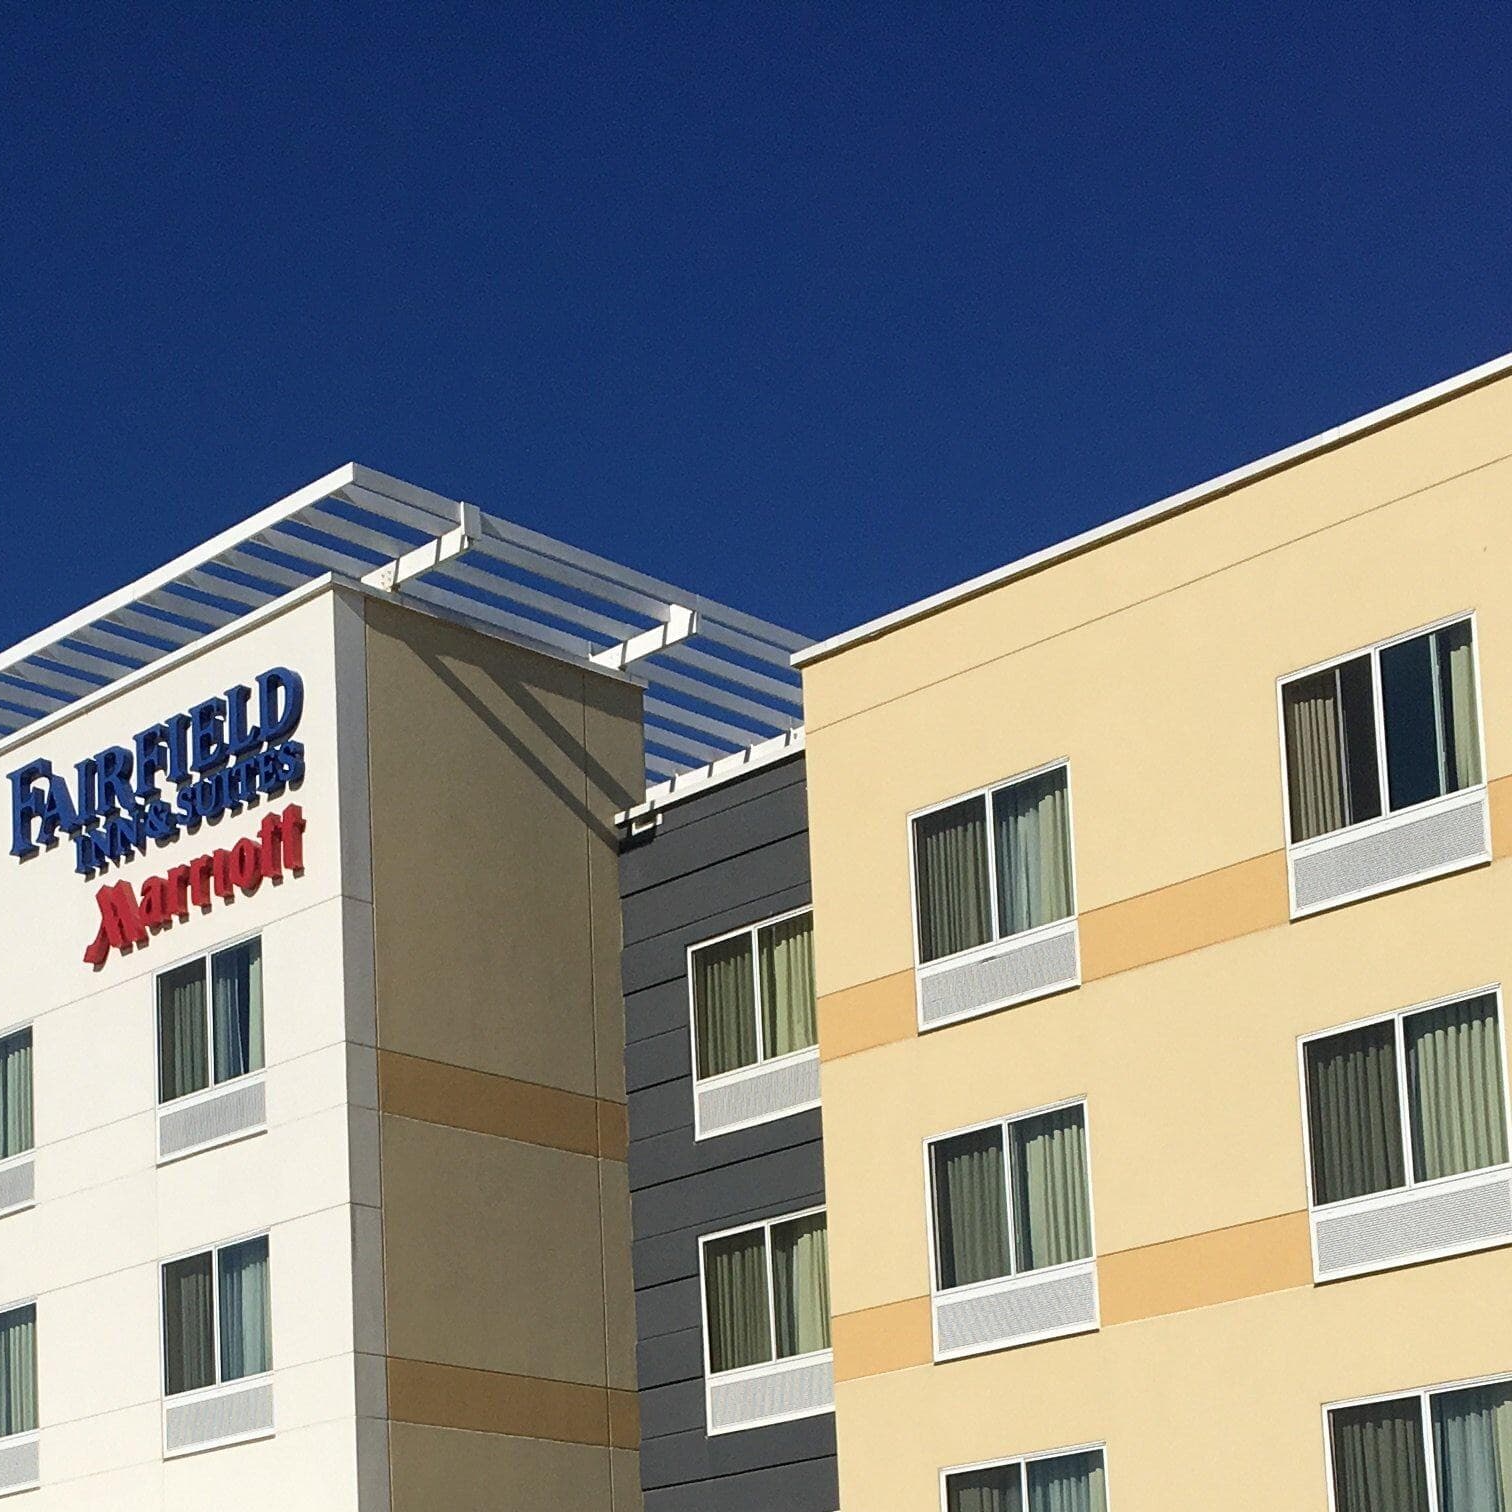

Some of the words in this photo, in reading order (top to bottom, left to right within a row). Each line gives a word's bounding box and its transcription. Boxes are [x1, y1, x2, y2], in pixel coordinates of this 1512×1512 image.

[6, 667, 305, 862] FAIRFIELD
[74, 805, 146, 880] INN
[144, 800, 180, 847] &
[177, 741, 305, 832] SUITES
[83, 803, 307, 968] Marriott
